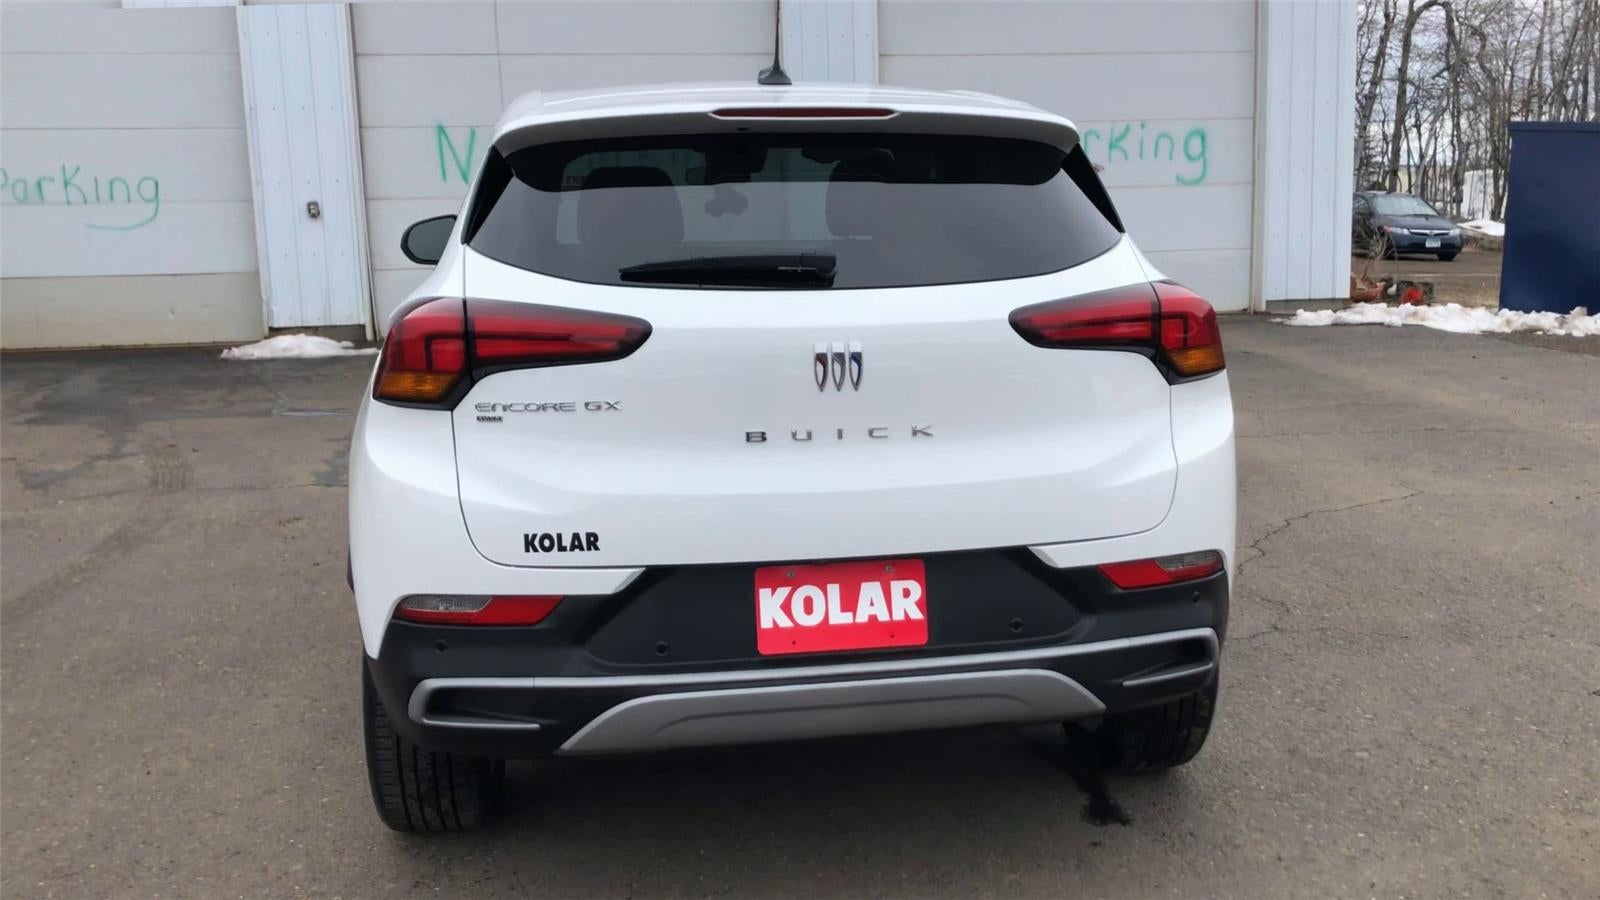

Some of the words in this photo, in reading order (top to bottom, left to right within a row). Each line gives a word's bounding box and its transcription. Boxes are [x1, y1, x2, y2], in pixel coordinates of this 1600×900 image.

[584, 400, 621, 412] GX
[745, 425, 933, 443] BUICK
[523, 532, 600, 553] KOLAR
[758, 579, 924, 629] KOLAR
